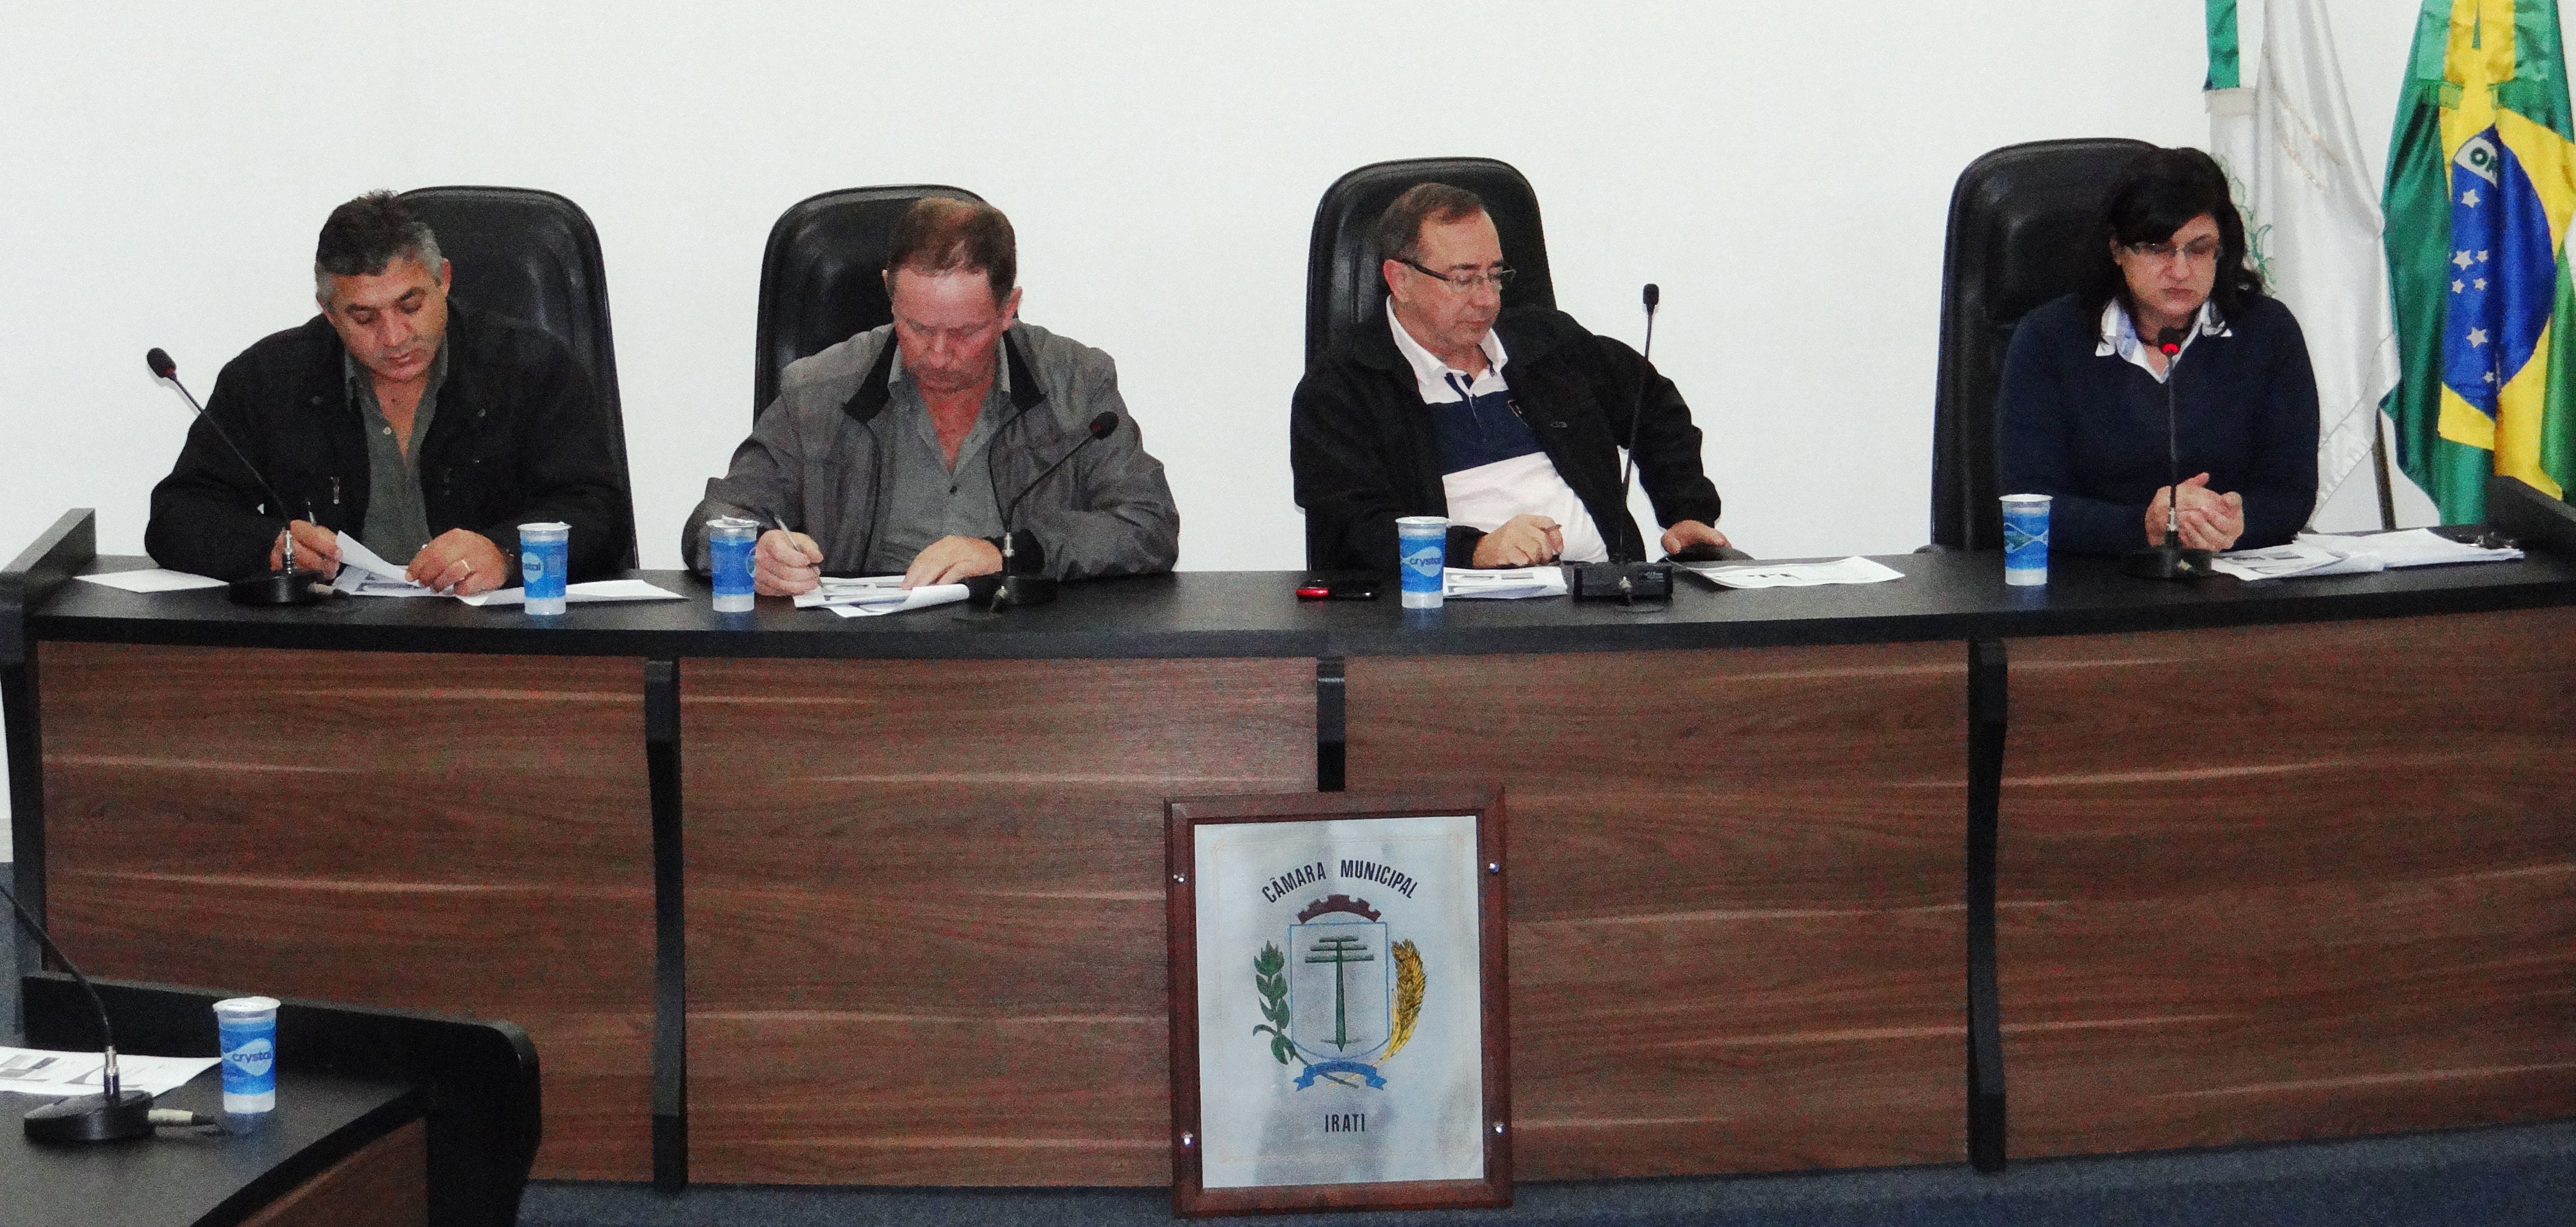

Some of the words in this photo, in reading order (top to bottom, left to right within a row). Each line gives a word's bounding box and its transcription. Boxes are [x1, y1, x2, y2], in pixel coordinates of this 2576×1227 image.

[1262, 862, 1326, 903] CÂMARA
[1340, 859, 1418, 899] MUNICIPAL
[231, 1050, 272, 1063] crystal
[1325, 1114, 1365, 1132] IRATI
